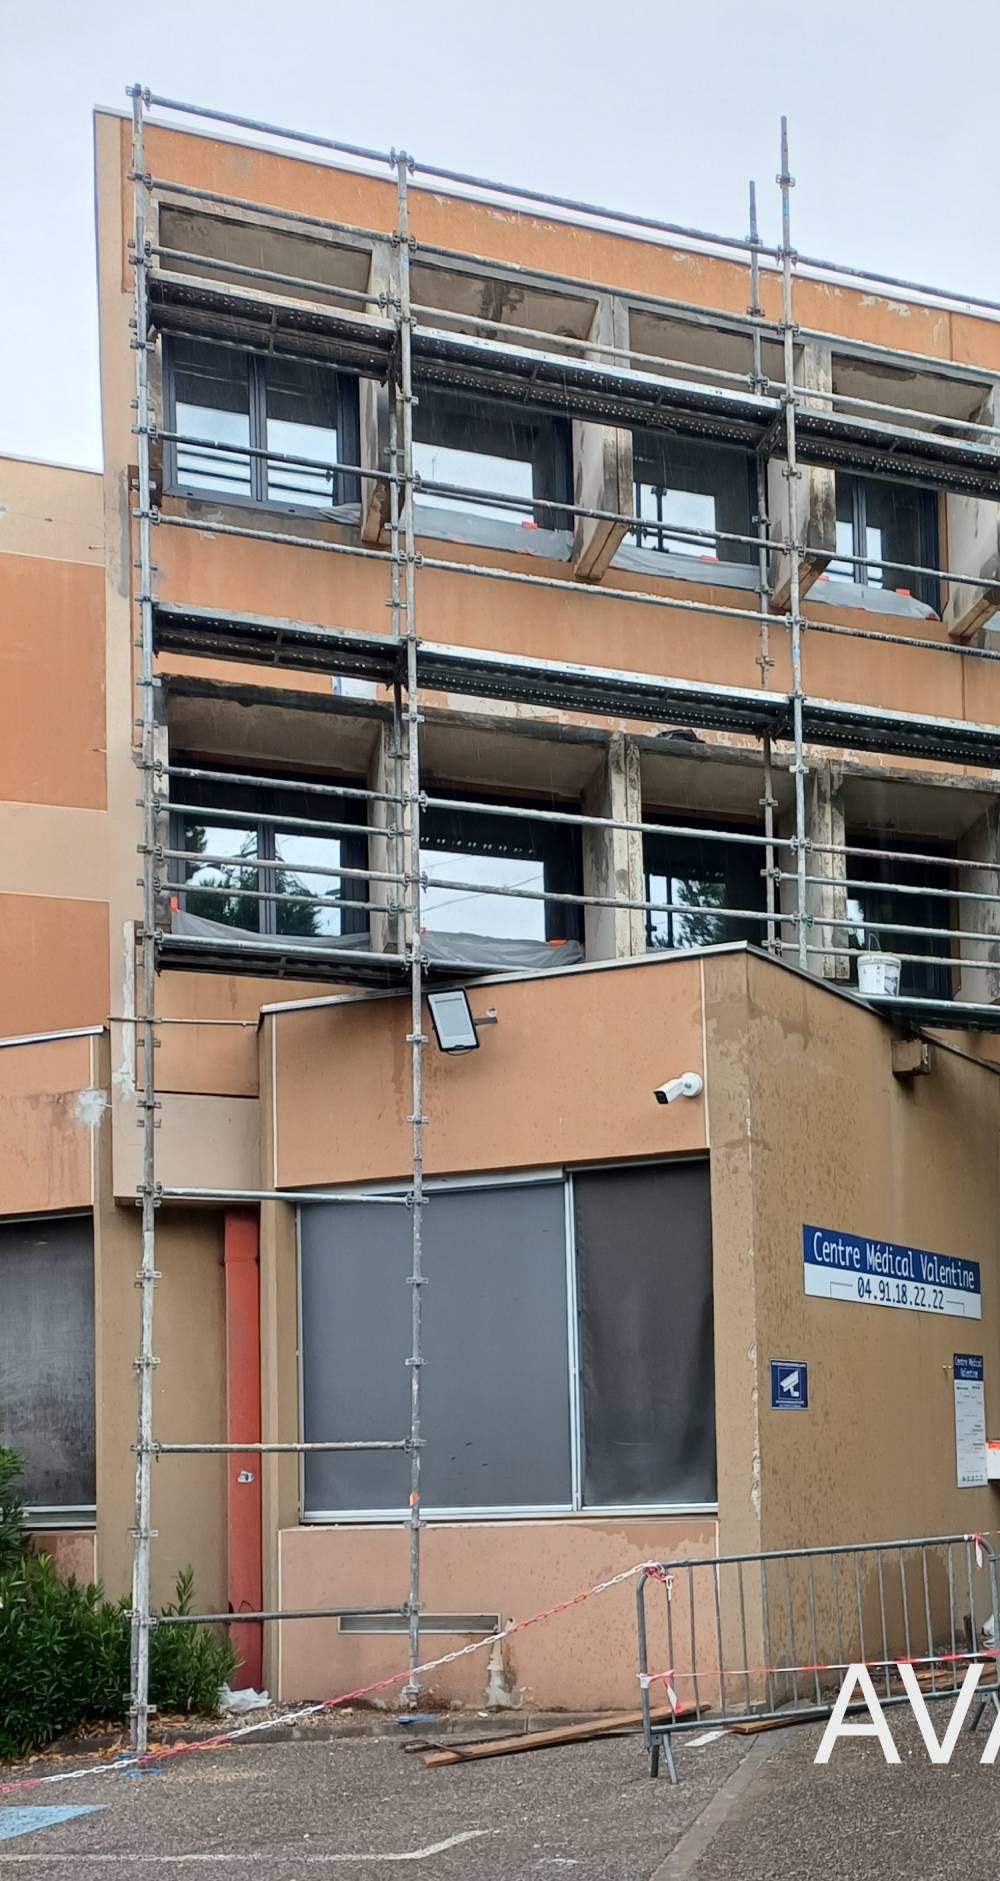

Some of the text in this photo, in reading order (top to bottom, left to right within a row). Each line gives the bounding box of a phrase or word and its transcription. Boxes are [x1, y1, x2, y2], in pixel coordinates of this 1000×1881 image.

[813, 1231, 975, 1289] Centre Médical Valentine
[857, 1276, 944, 1310] 04.91.18.22.22
